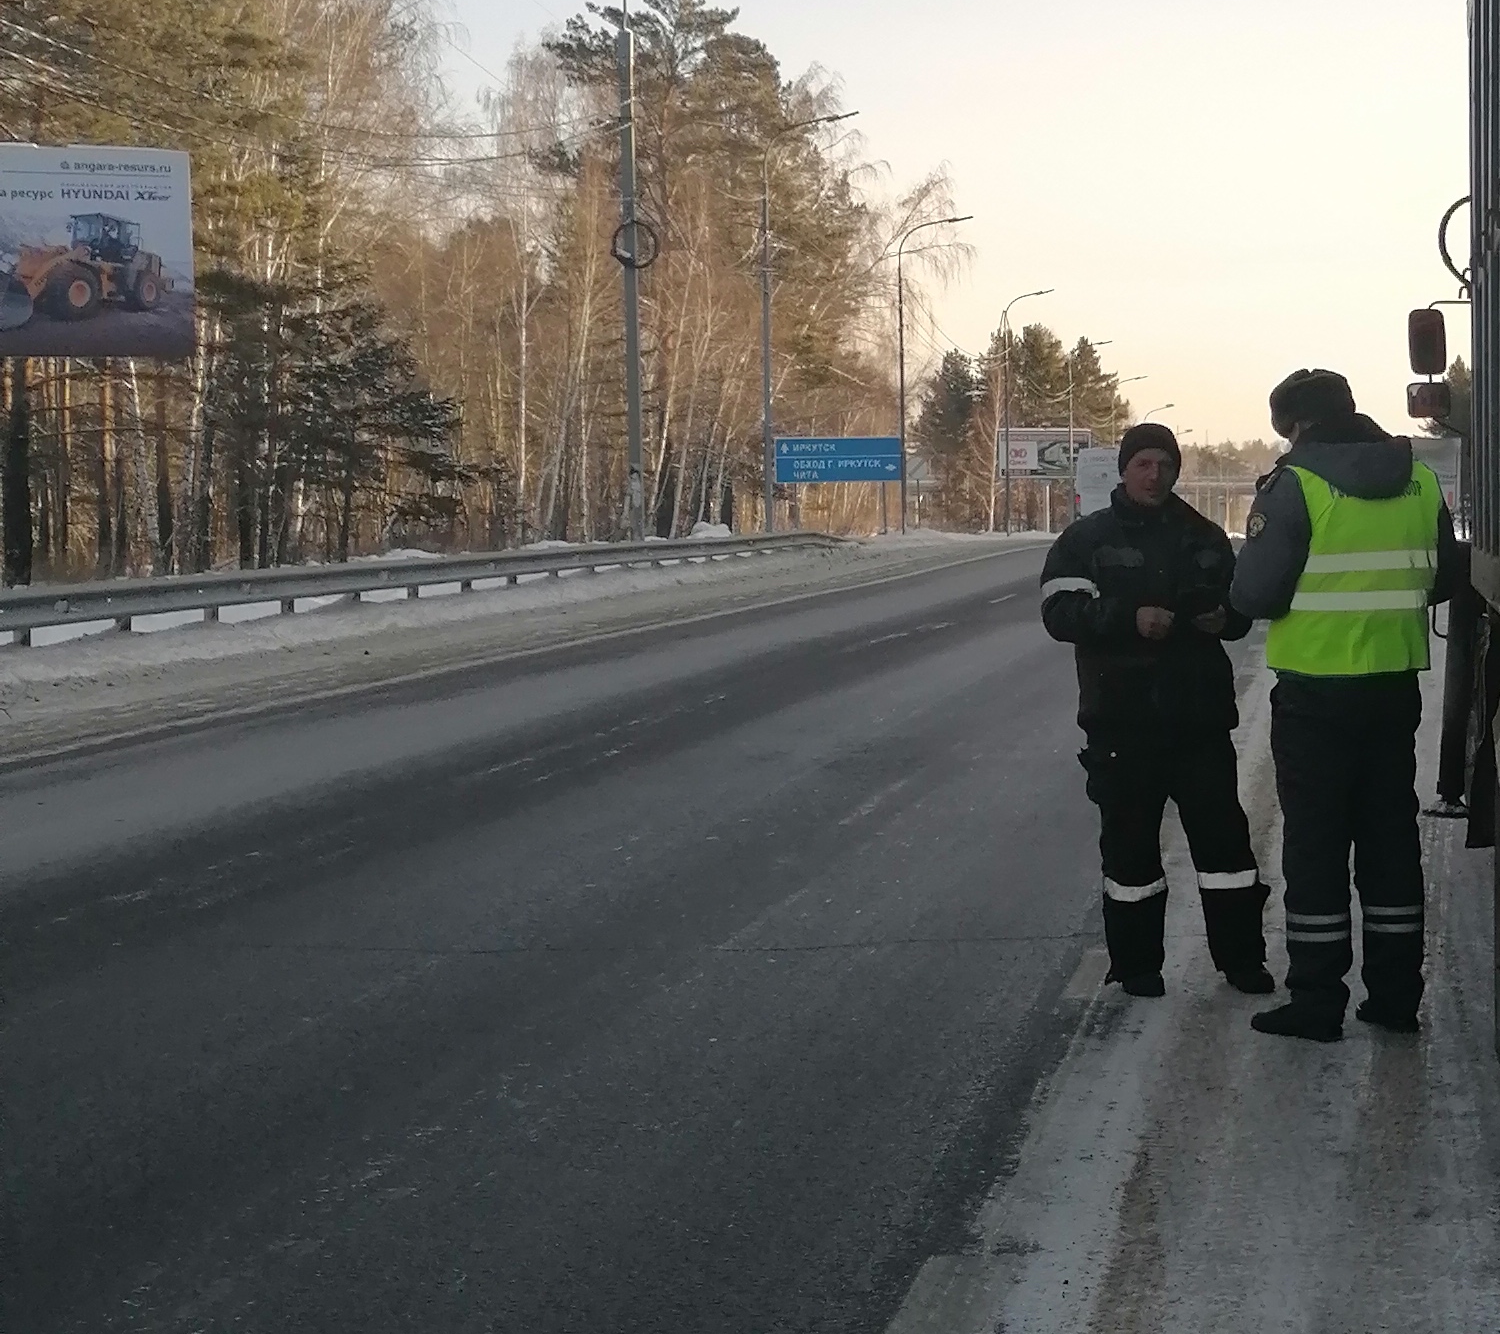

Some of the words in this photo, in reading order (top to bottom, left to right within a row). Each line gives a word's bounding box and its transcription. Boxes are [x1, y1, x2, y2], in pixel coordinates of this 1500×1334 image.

[73, 161, 172, 173] angara-resurs.ru
[10, 190, 54, 200] ресурс
[61, 188, 130, 201] HYUNDAI
[792, 443, 836, 453] ИРКУТСК
[793, 460, 826, 470] ОБХОД
[838, 458, 881, 468] ИРКУТСК
[793, 470, 819, 480] ЧИТА
